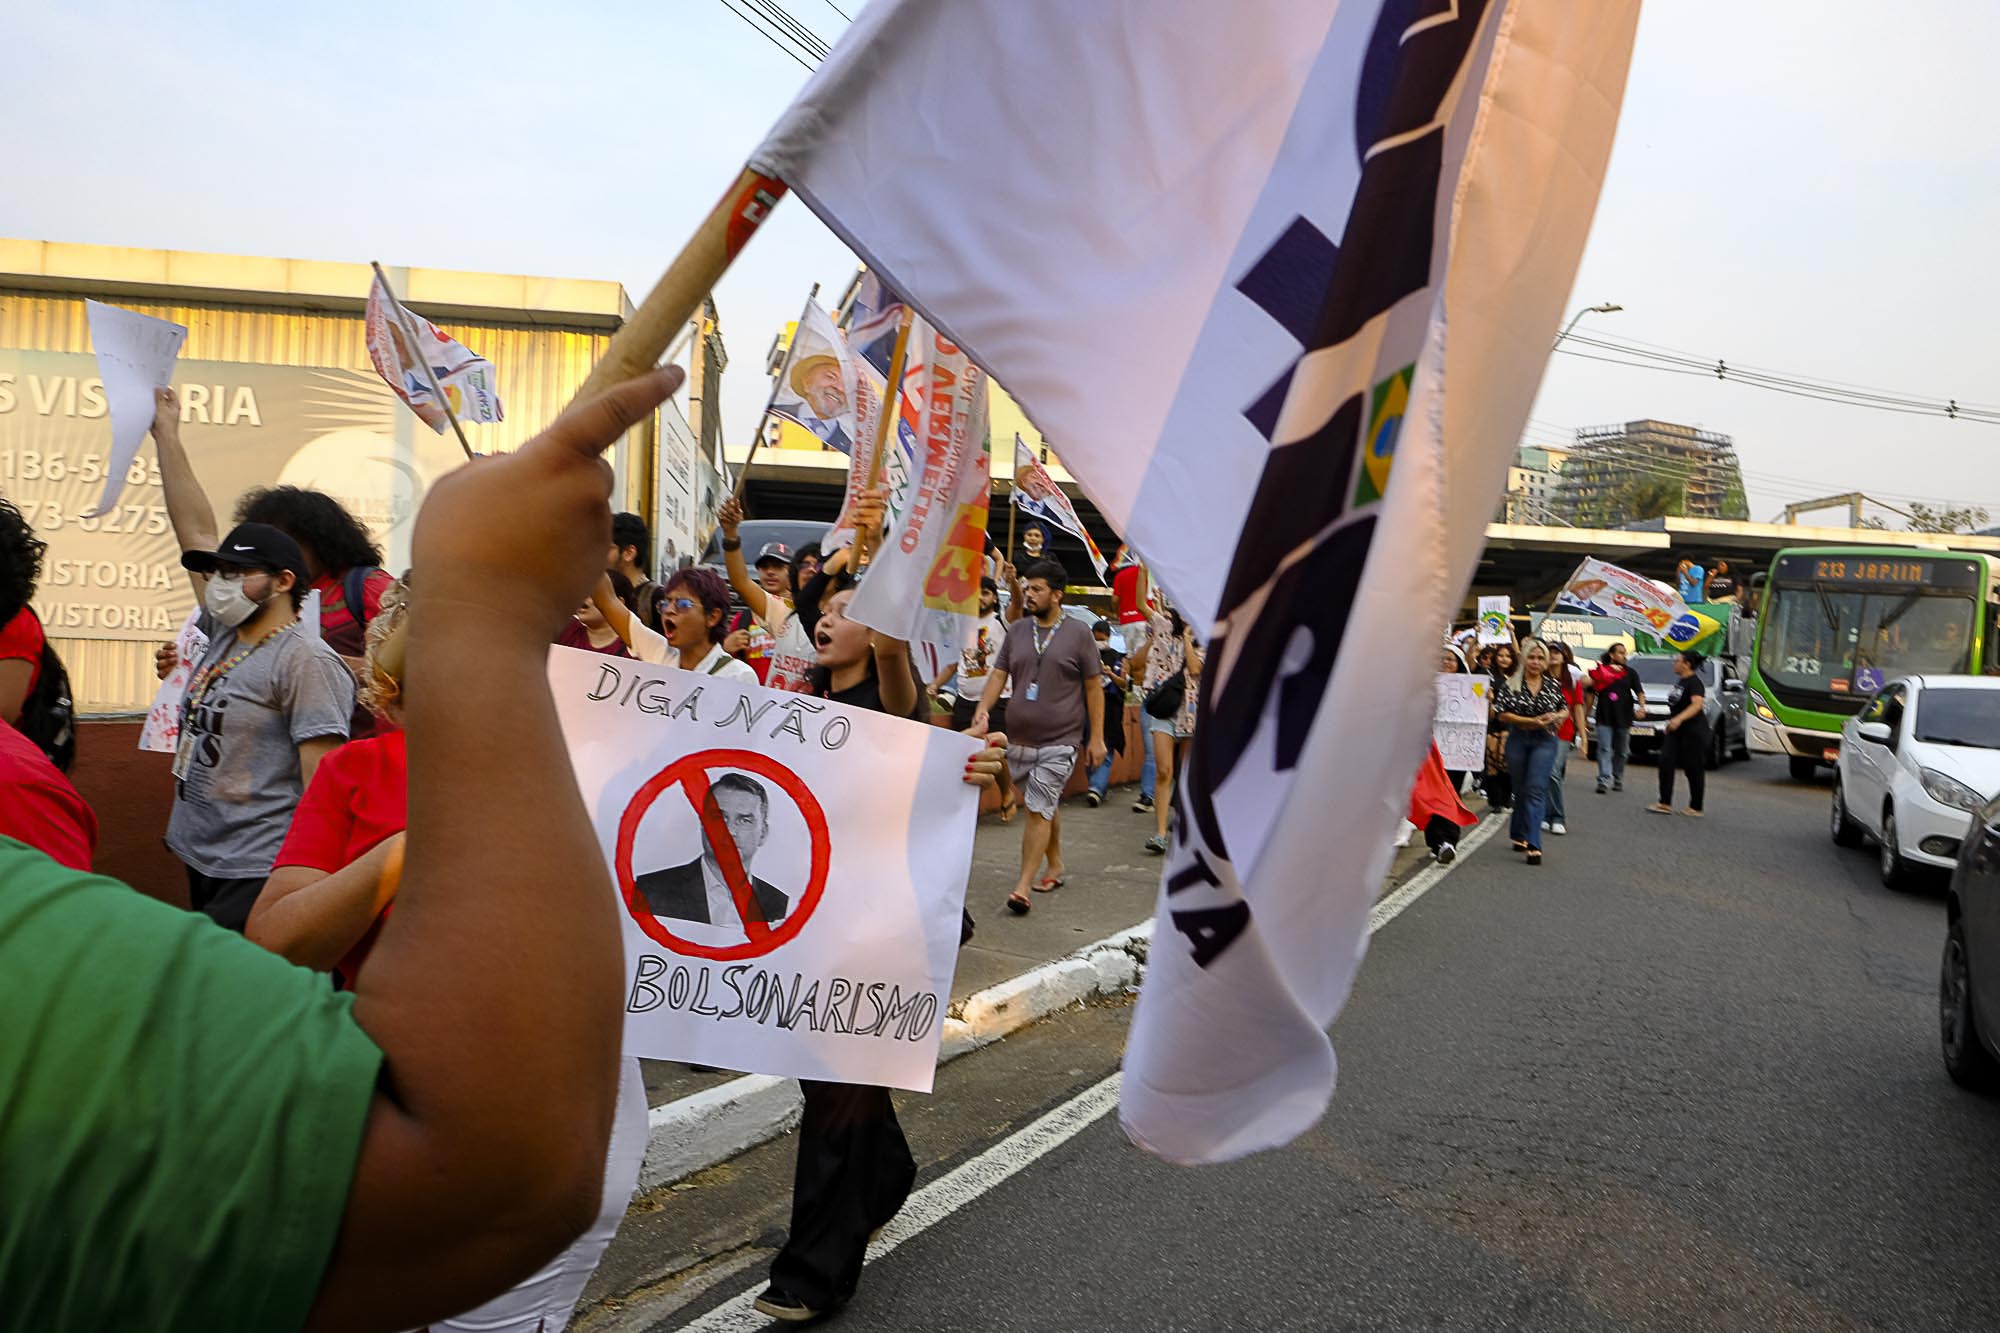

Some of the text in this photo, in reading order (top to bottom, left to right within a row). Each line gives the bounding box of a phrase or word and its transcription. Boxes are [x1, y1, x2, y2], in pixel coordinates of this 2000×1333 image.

[28, 374, 262, 427] VISRIA
[1, 450, 163, 487] 136-585
[1817, 560, 1846, 579] 213
[36, 601, 173, 632] VISTORIA
[1785, 656, 1822, 675] 213
[587, 662, 705, 722] DIGA
[714, 694, 851, 751] NÃO
[627, 954, 939, 1042] BOLSONARISMO
